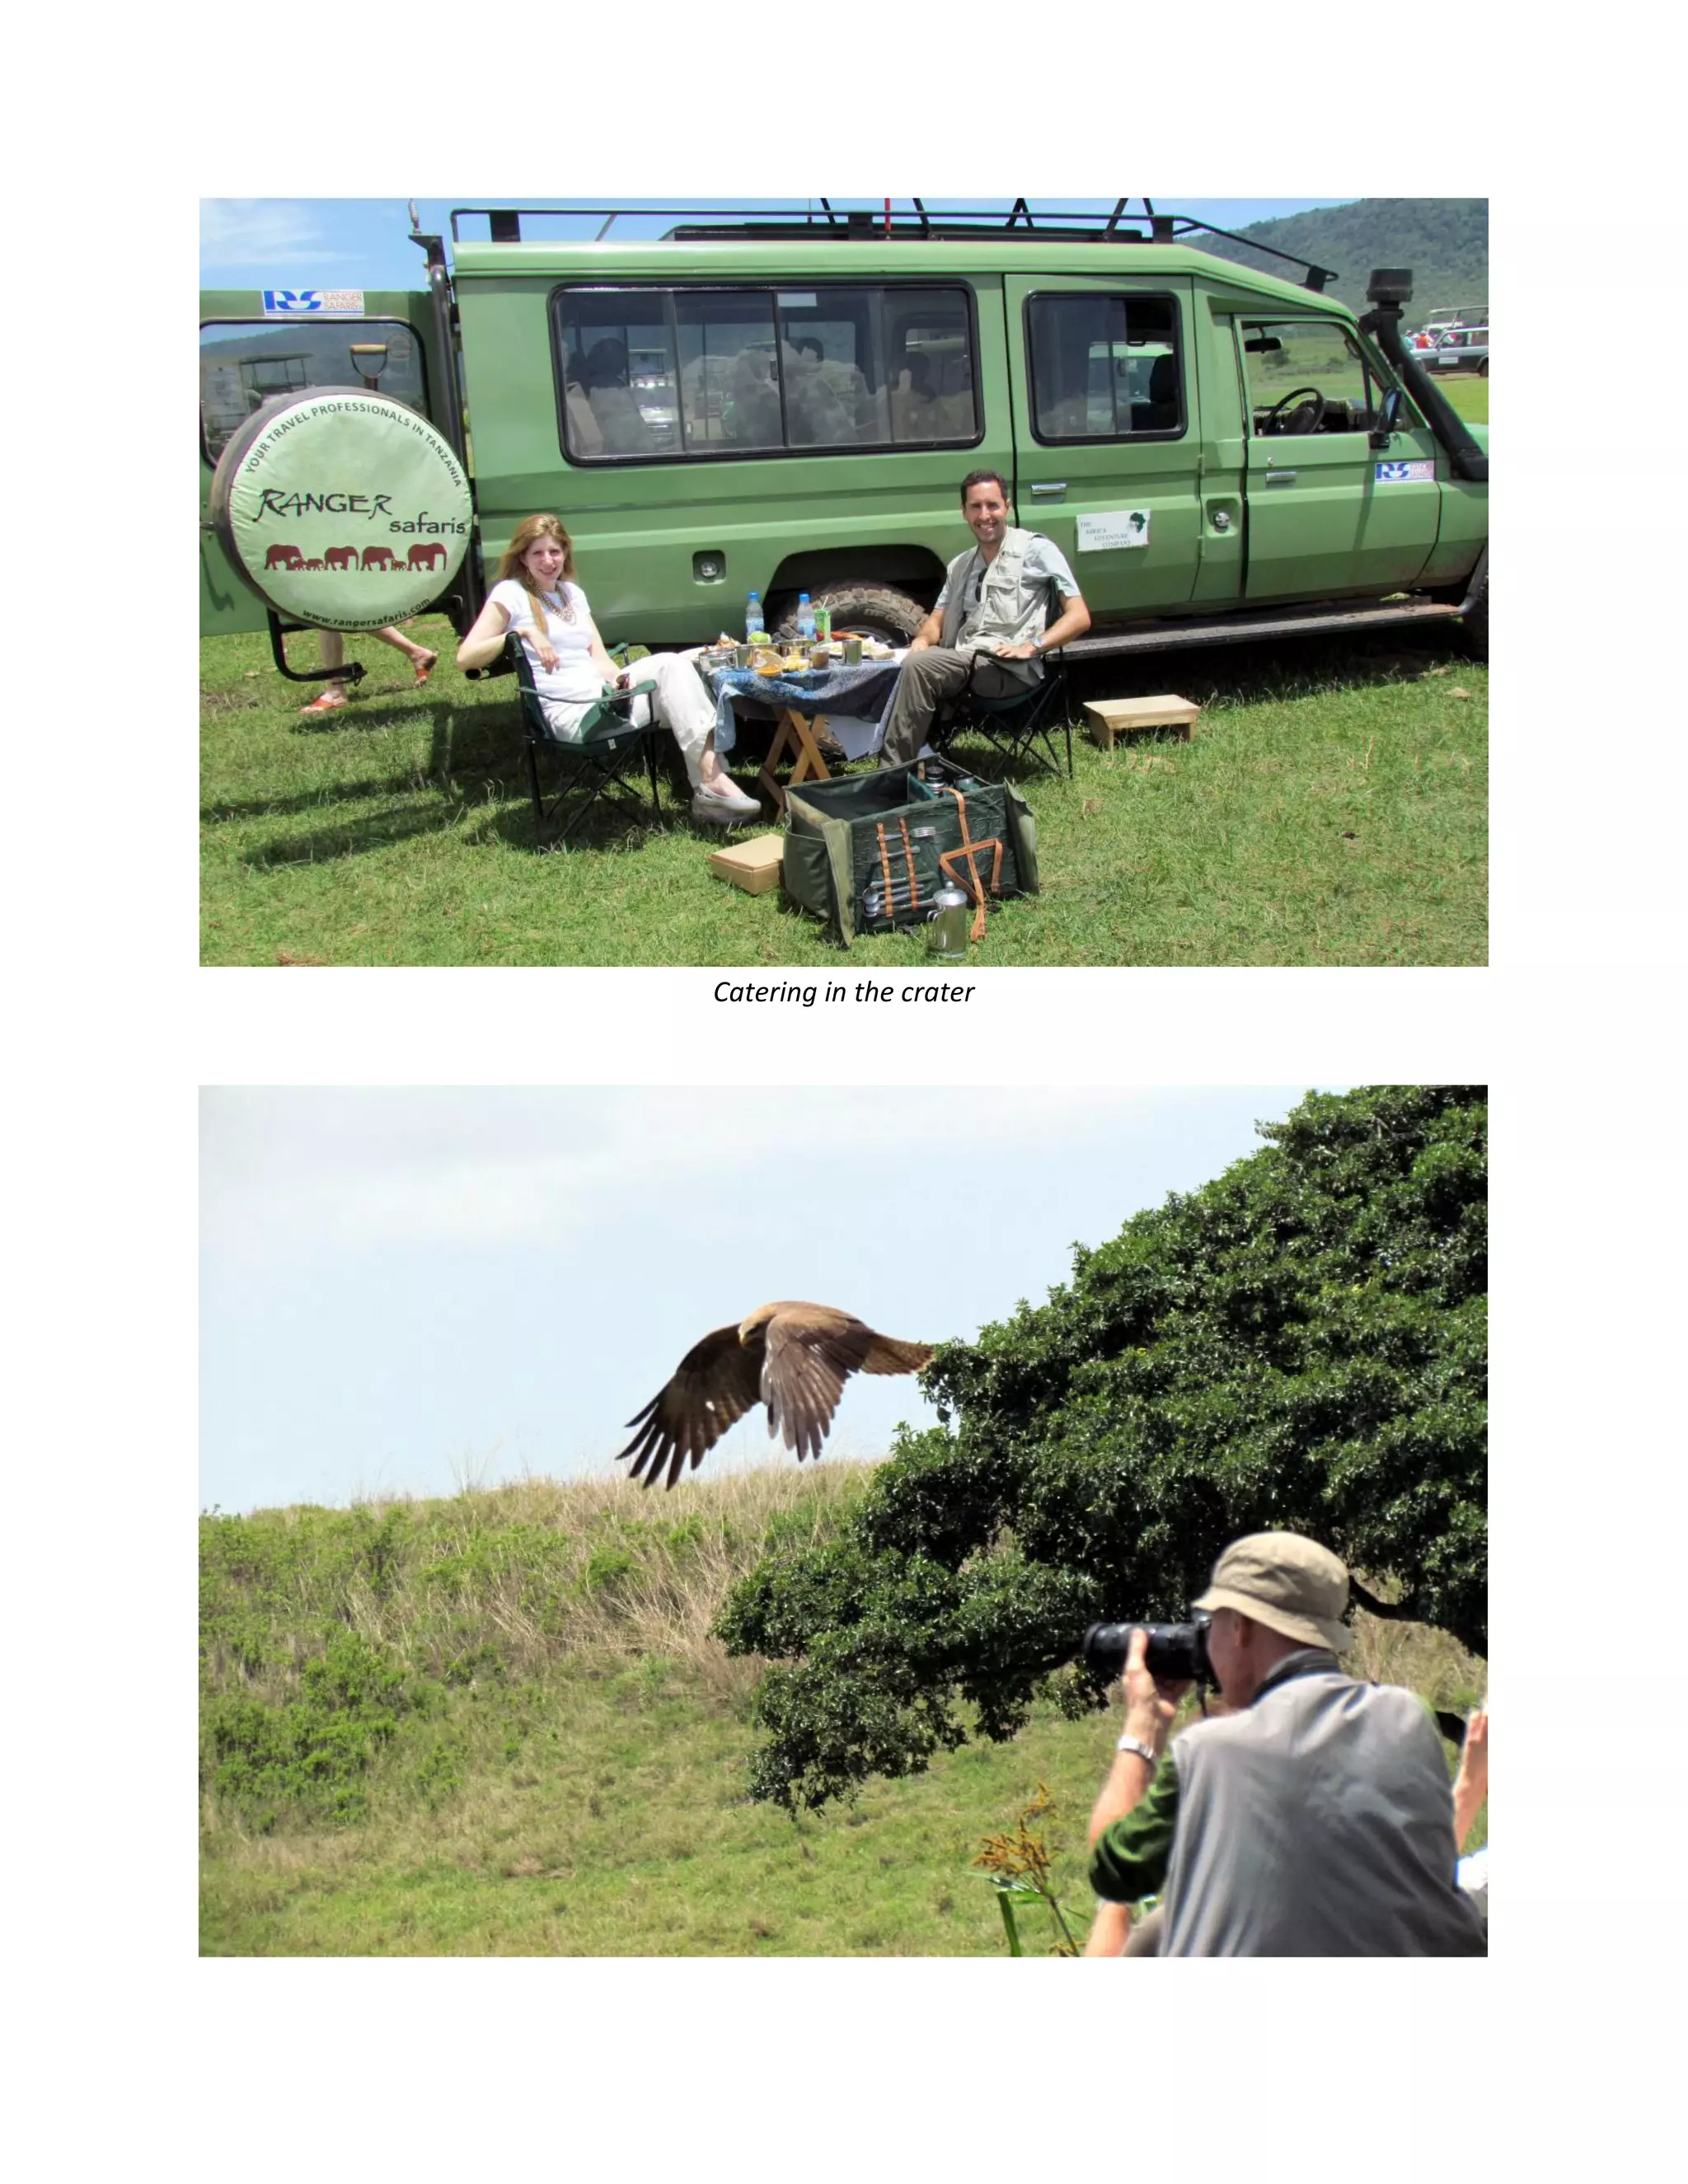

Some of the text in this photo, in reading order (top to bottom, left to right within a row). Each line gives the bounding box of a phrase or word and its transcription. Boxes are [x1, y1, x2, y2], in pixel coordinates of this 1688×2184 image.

[323, 293, 362, 301] RANGER
[245, 401, 462, 487] YOUR TRAVEL PROFESSIONALS IN TANZANIA
[252, 488, 392, 522] RANGER
[389, 511, 466, 534] safaris
[302, 597, 430, 628] www.rangersafaris.com
